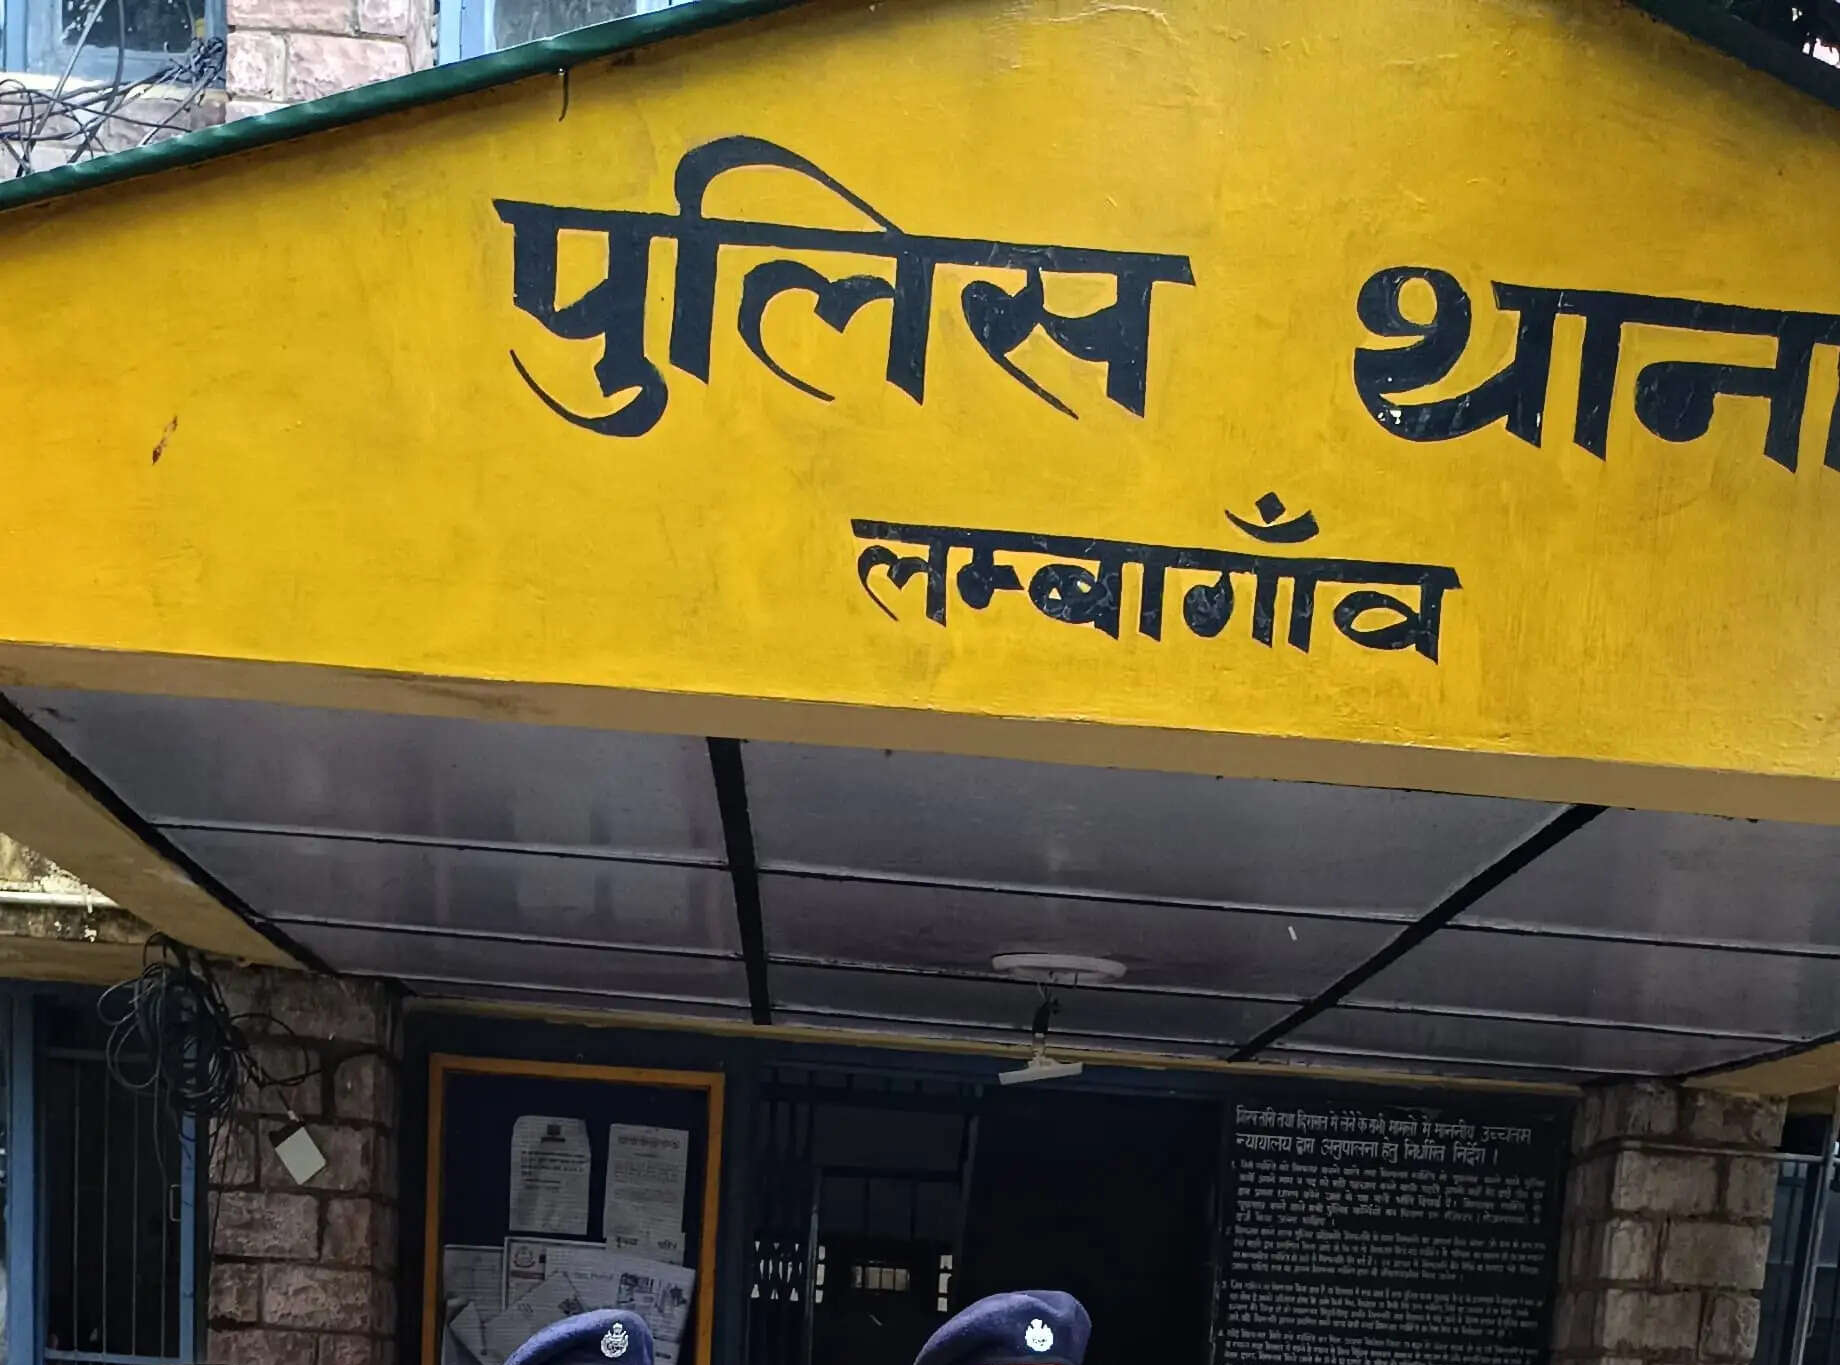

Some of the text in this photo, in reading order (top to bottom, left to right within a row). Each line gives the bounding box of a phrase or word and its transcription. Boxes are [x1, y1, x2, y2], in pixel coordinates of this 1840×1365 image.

[493, 135, 1840, 474] पुलिस थाना
[851, 492, 1461, 665] लम्बागाँव
[1234, 1132, 1293, 1153] न्यायालय
[1320, 1137, 1379, 1162] अनुपालना
[1479, 1125, 1532, 1146] उच्चतम
